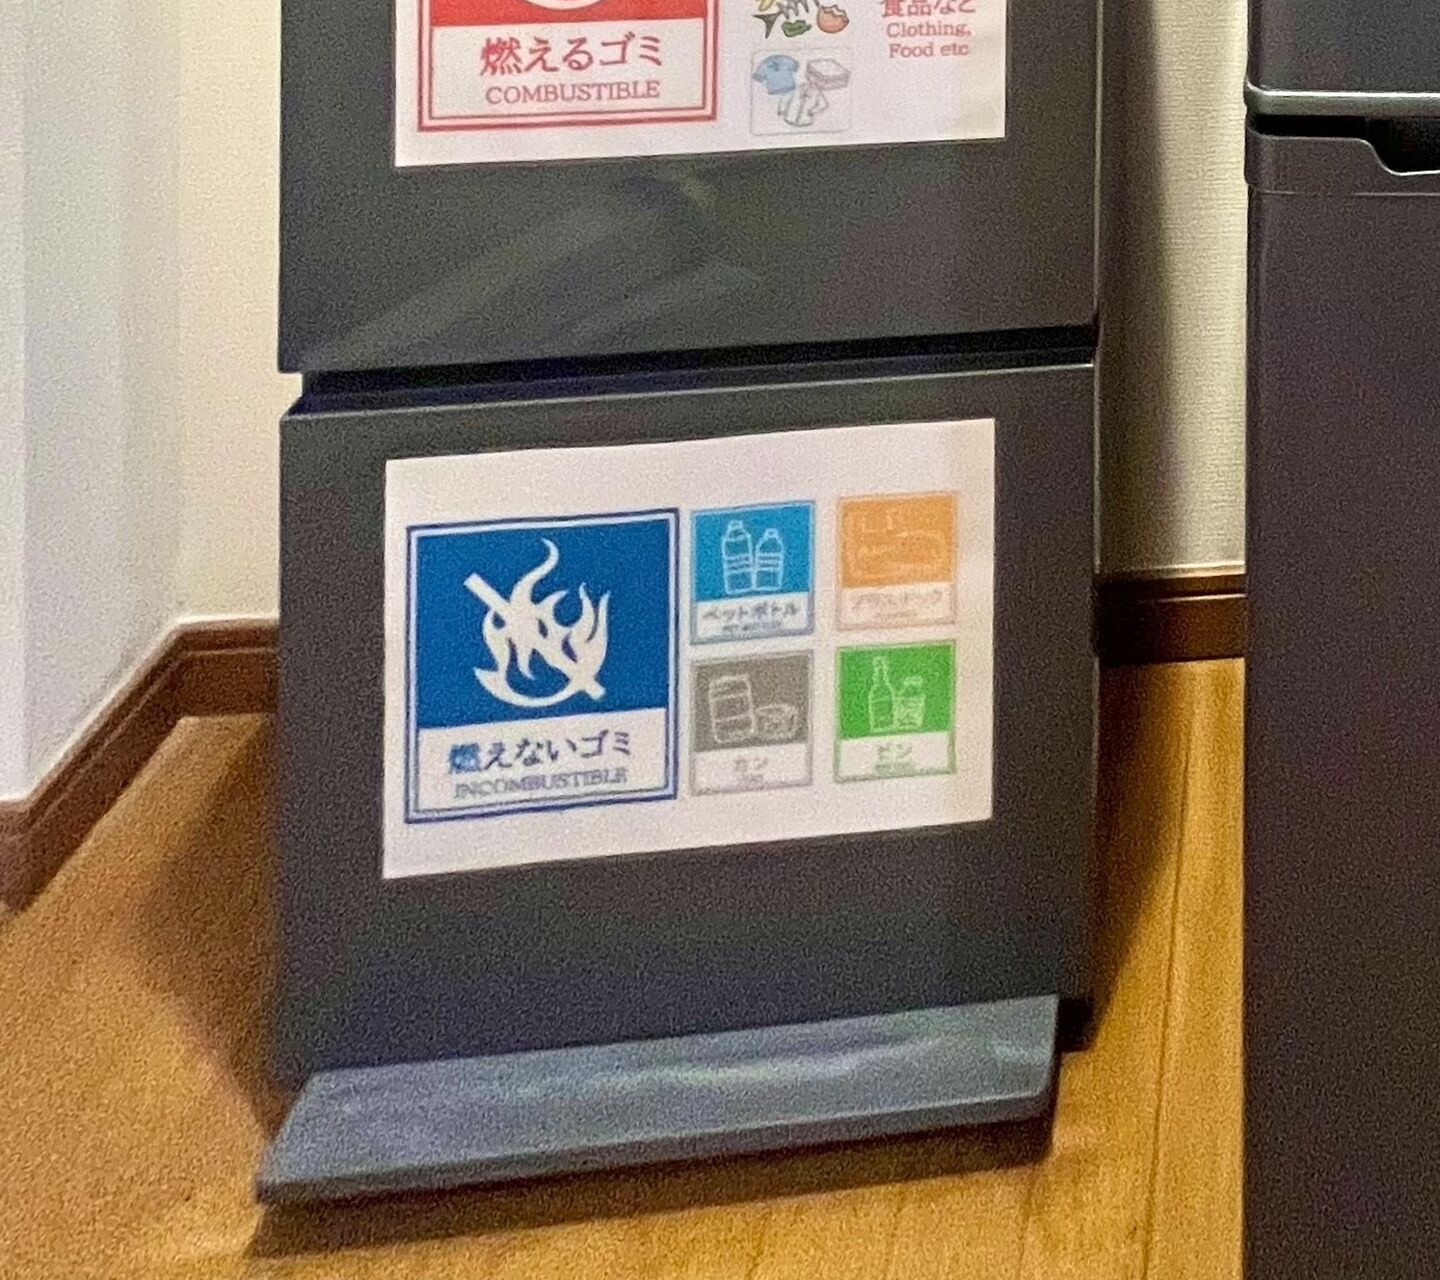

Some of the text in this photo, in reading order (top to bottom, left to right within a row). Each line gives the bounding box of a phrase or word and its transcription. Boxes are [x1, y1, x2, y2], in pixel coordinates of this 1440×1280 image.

[886, 22, 972, 40] Clothing,
[480, 31, 662, 76] 燃えるゴミ
[889, 42, 969, 59] Food etc
[485, 80, 661, 105] COMBUSTIBLE
